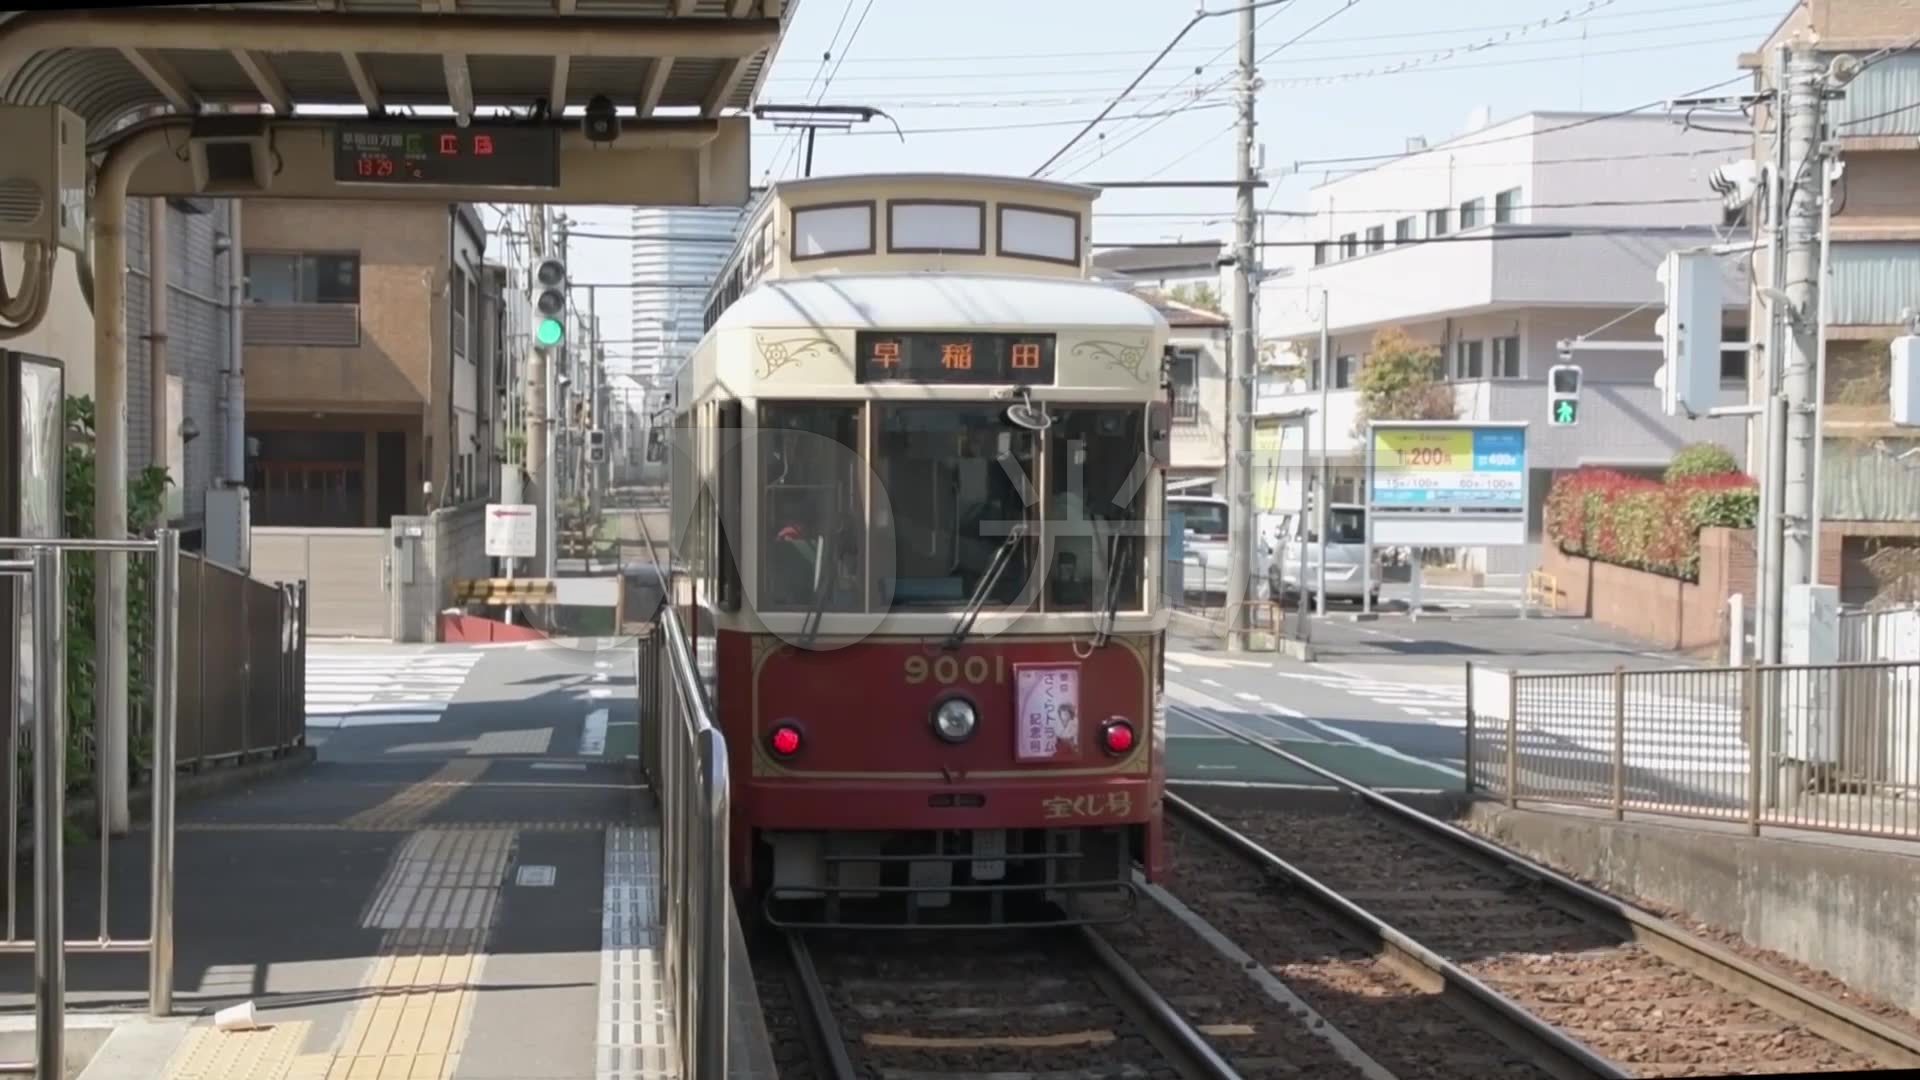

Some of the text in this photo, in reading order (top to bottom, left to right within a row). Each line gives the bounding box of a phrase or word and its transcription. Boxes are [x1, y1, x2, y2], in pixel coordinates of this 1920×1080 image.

[872, 342, 1040, 369] 早稲田
[904, 655, 1004, 685] 9001
[1042, 790, 1133, 819] 宝くじ号
